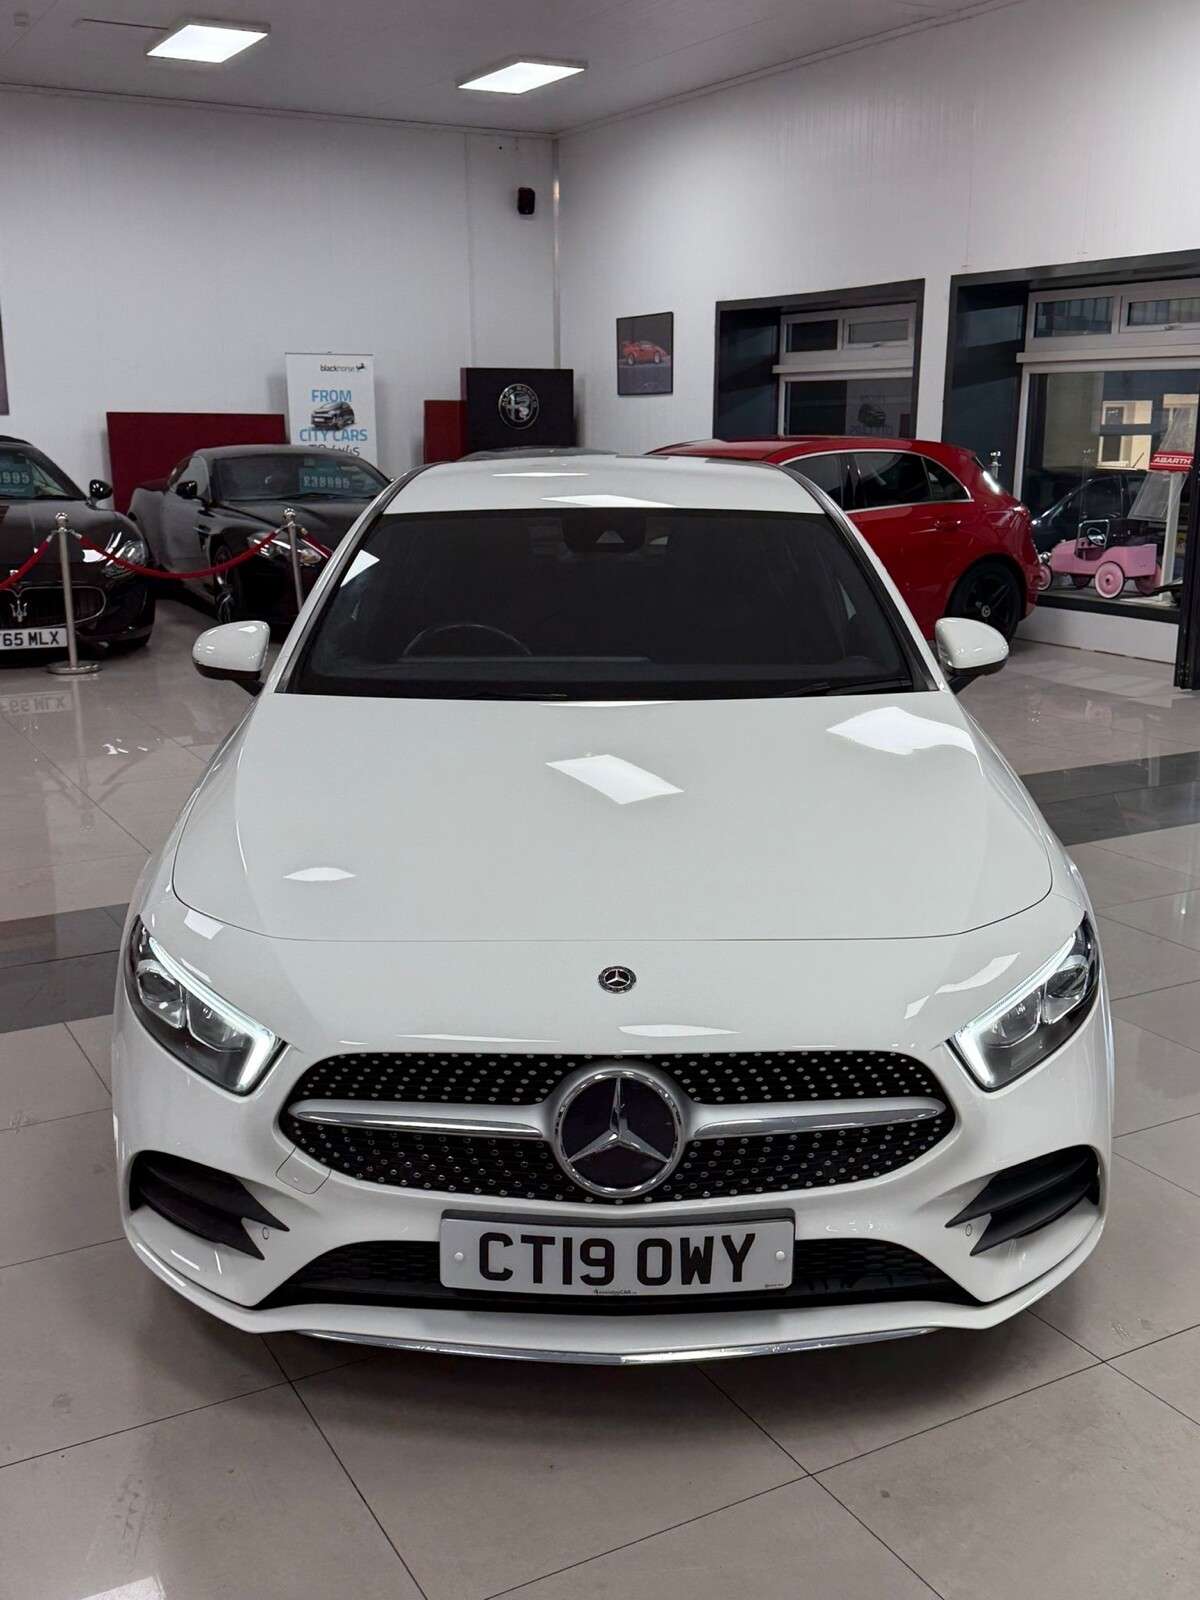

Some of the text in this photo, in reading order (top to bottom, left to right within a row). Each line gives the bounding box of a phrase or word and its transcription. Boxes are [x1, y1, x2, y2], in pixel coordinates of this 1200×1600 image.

[311, 389, 353, 403] FROM
[299, 428, 368, 442] CITY CARS
[1154, 457, 1192, 465] ABARTH
[0, 471, 30, 485] 995
[0, 630, 60, 647] 65 MLX
[478, 1231, 757, 1287] CT19 OWY
